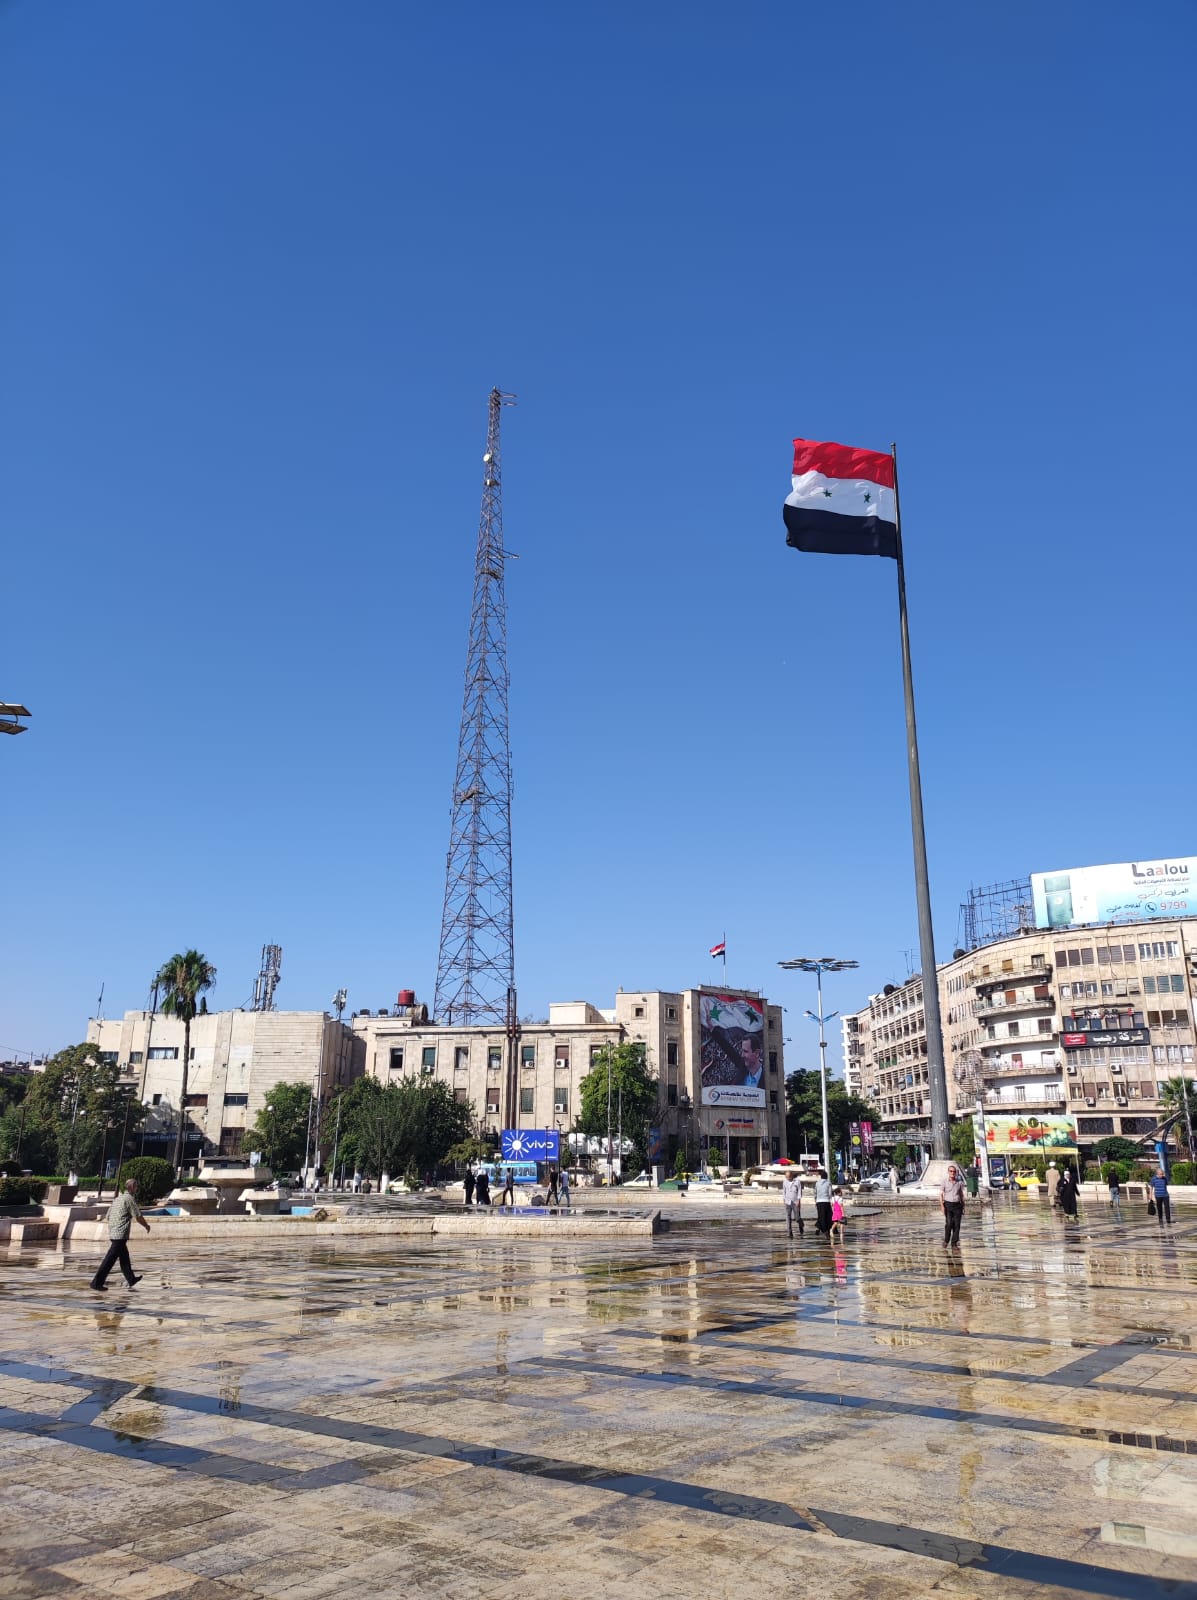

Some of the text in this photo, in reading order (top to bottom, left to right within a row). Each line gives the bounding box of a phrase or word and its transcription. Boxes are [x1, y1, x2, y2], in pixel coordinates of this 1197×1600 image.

[1132, 863, 1188, 877] Laalou
[1160, 900, 1187, 911] 9799
[1118, 1030, 1144, 1043] شركة
[526, 1139, 554, 1149] vivo
